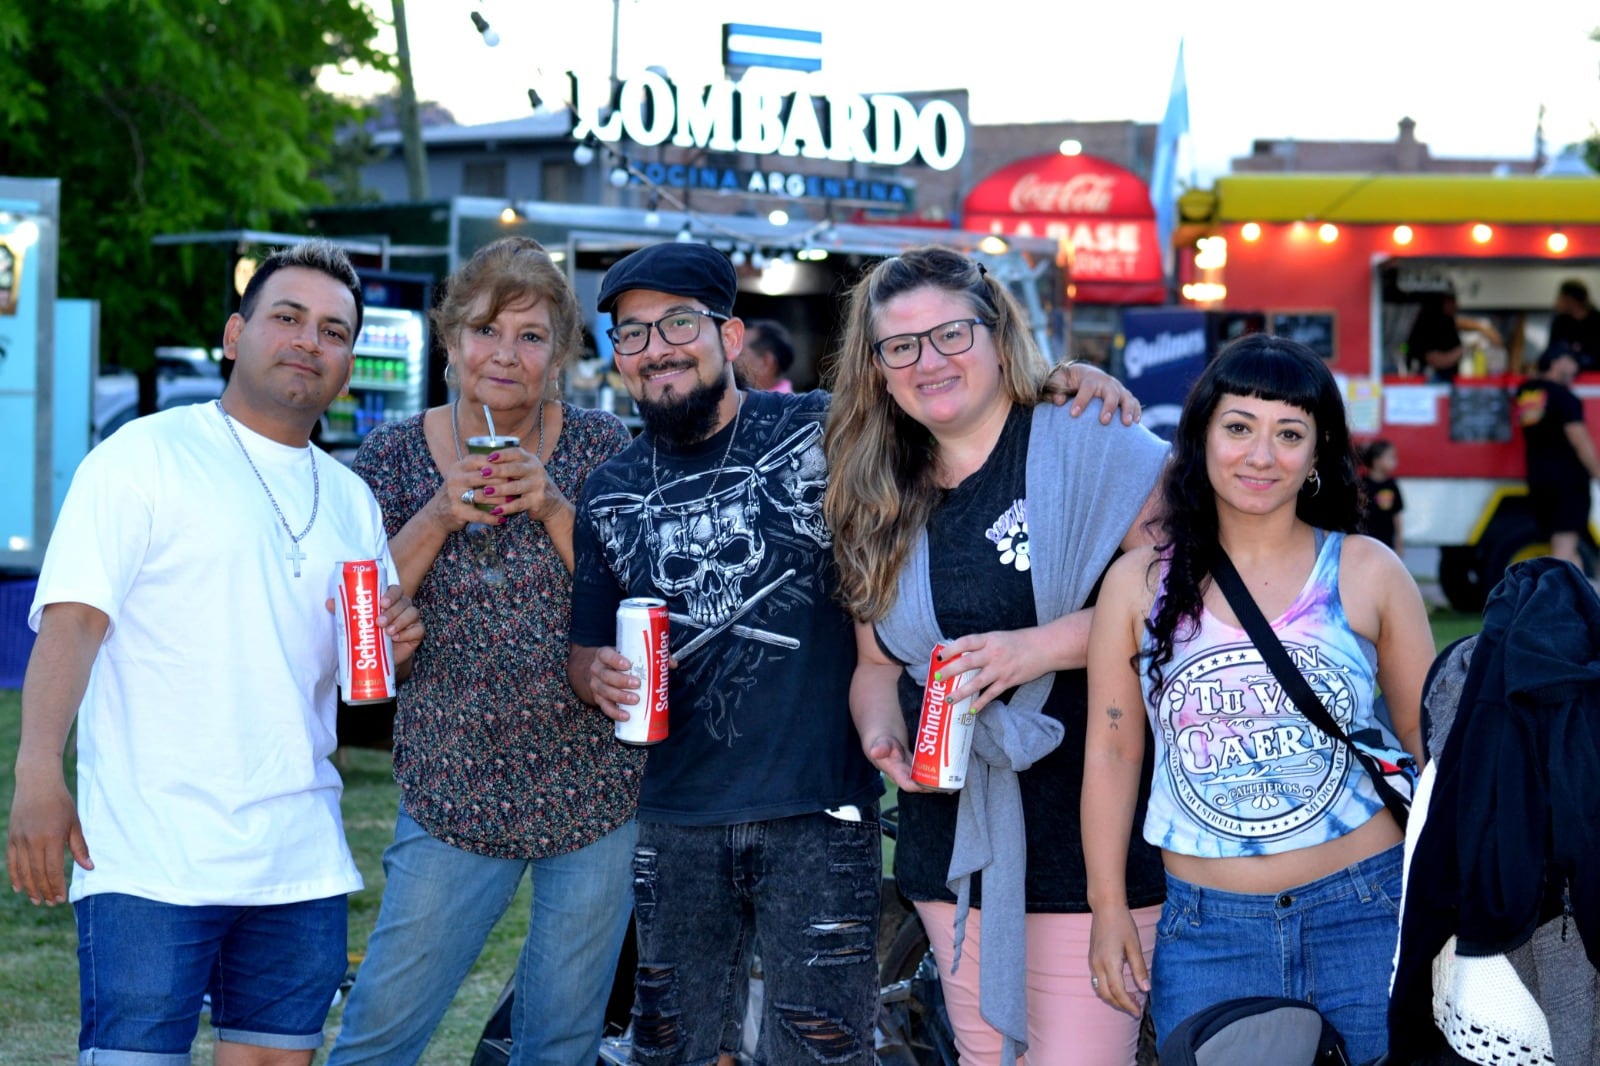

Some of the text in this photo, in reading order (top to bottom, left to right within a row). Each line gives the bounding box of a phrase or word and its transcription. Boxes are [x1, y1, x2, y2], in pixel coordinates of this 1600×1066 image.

[572, 68, 966, 171] LOMBARDO
[747, 170, 906, 204] ARGENTINA
[352, 588, 378, 670] Schneider
[655, 631, 670, 713] Schneider
[918, 678, 948, 756] Schneide
[1197, 802, 1242, 832] ESTRELLA
[1228, 781, 1301, 801] CALLEJEROS
[1305, 801, 1320, 817] MI
[1335, 758, 1346, 773] MI
